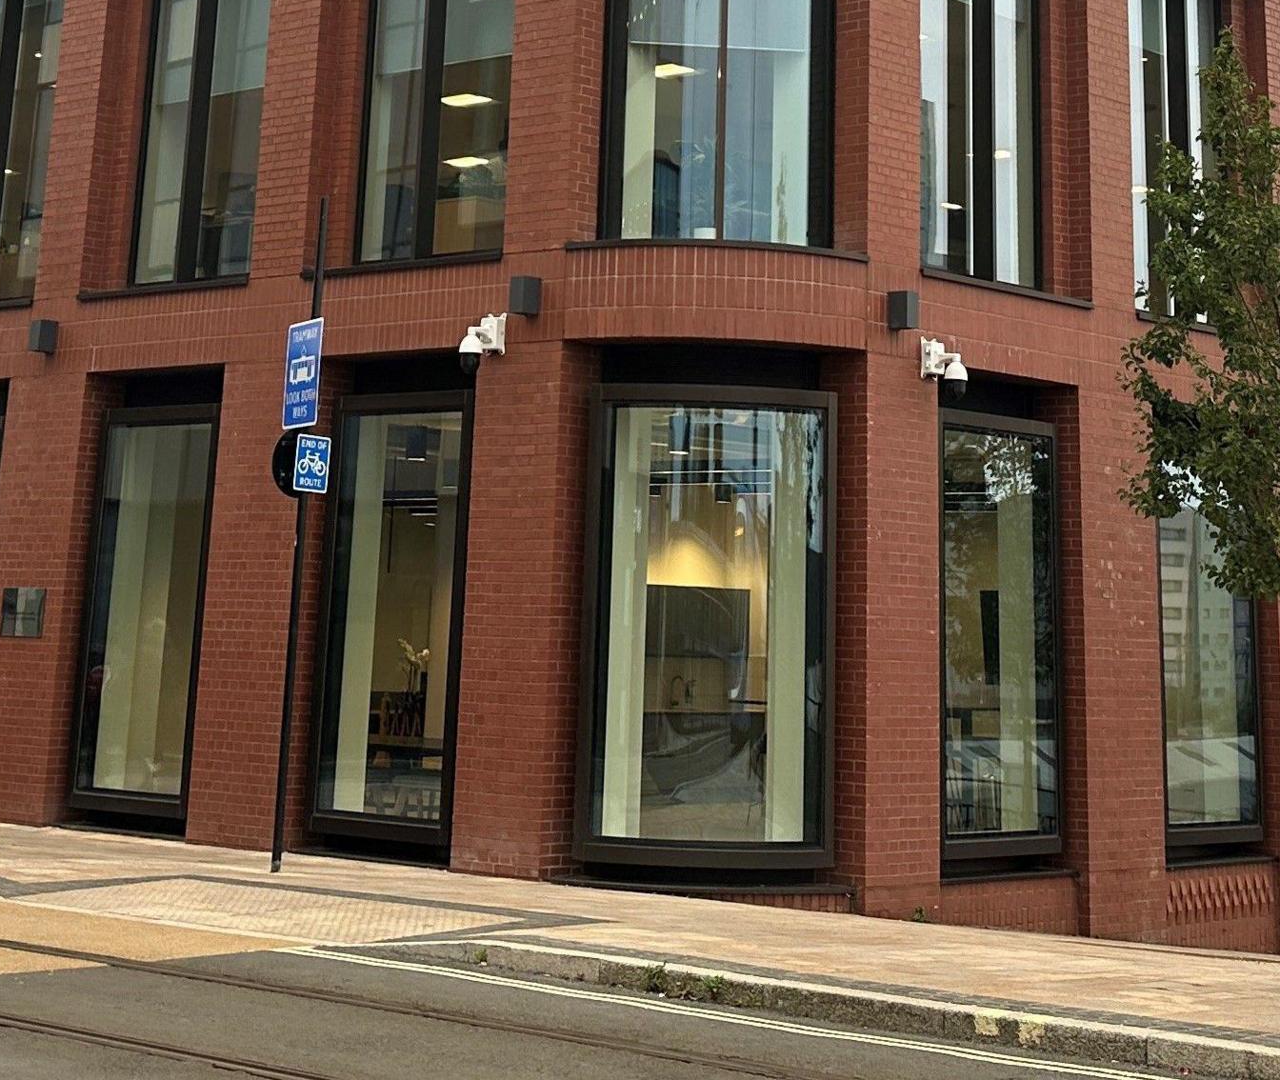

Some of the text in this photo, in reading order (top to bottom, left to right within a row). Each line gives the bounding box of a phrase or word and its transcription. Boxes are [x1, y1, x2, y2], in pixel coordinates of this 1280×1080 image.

[292, 326, 319, 343] TRAMWAY
[286, 387, 316, 405] LOOK BOTH
[292, 404, 308, 419] WAYS
[301, 438, 327, 450] END OF
[299, 476, 322, 488] ROUTE
